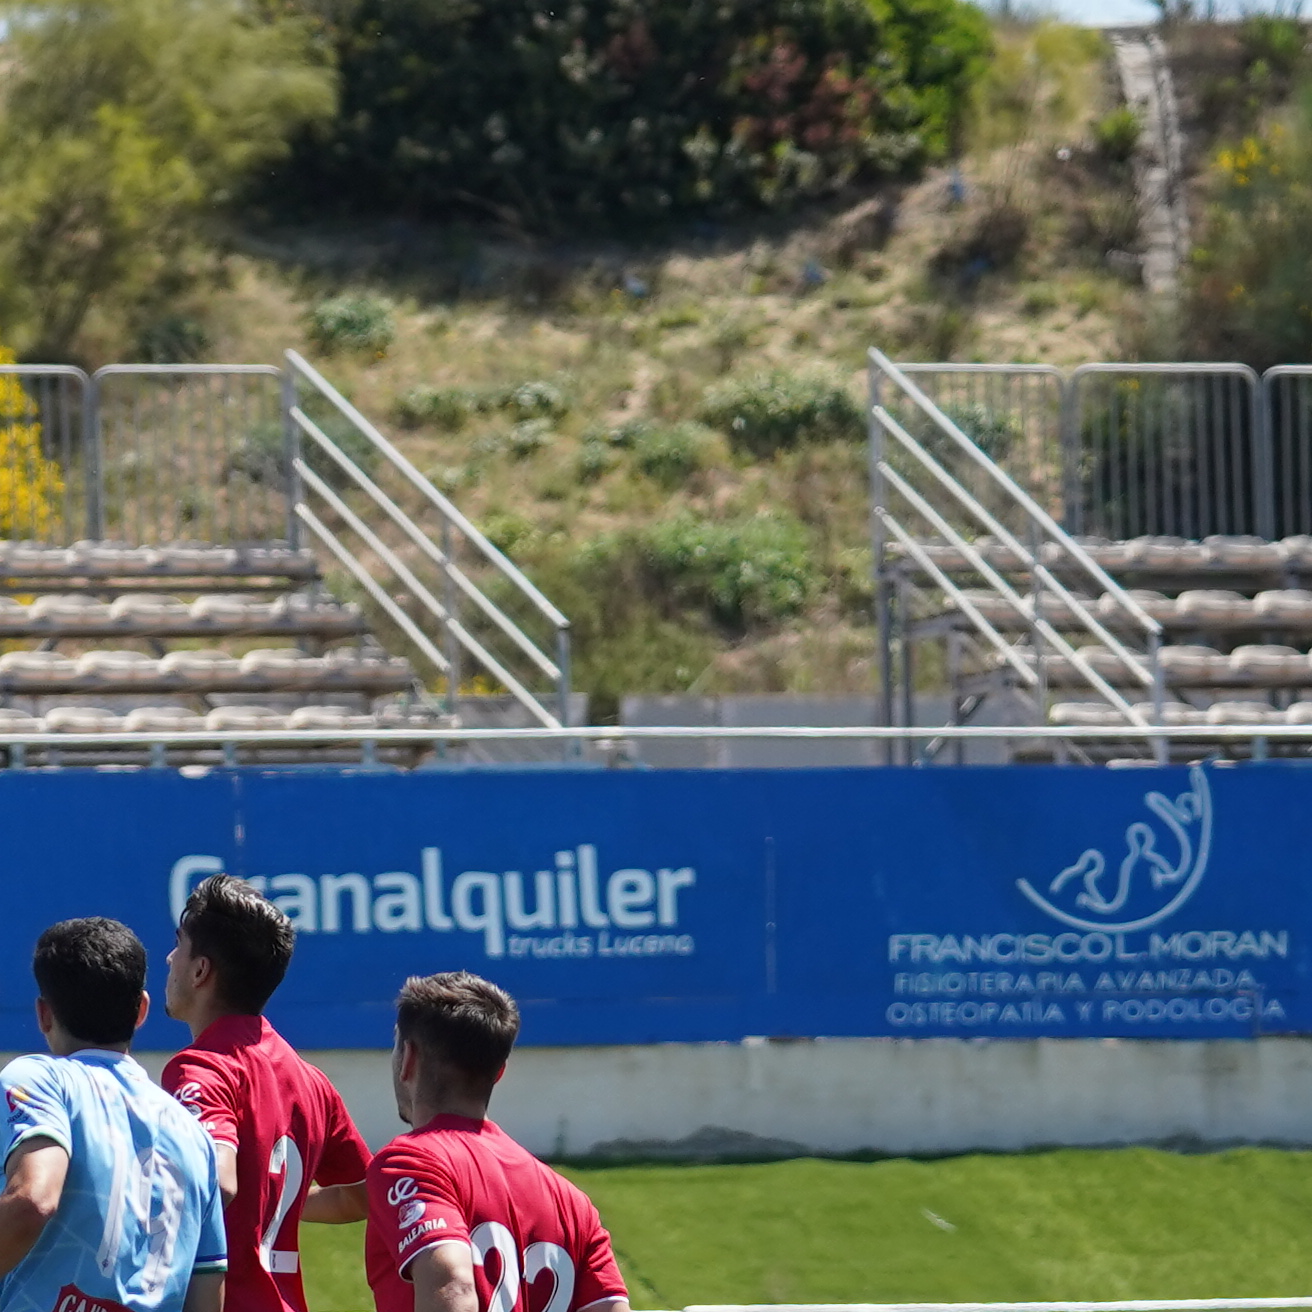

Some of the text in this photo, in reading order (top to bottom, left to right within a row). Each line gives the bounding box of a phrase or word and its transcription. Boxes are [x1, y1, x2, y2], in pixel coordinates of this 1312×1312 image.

[507, 932, 590, 957] trucks
[888, 932, 1112, 965] FRANCISCO
[1148, 930, 1289, 961] MORAN
[893, 967, 1260, 997] FISIOTERAPIA AVANZADA
[1077, 1000, 1092, 1023] Y
[258, 1134, 304, 1274] 2
